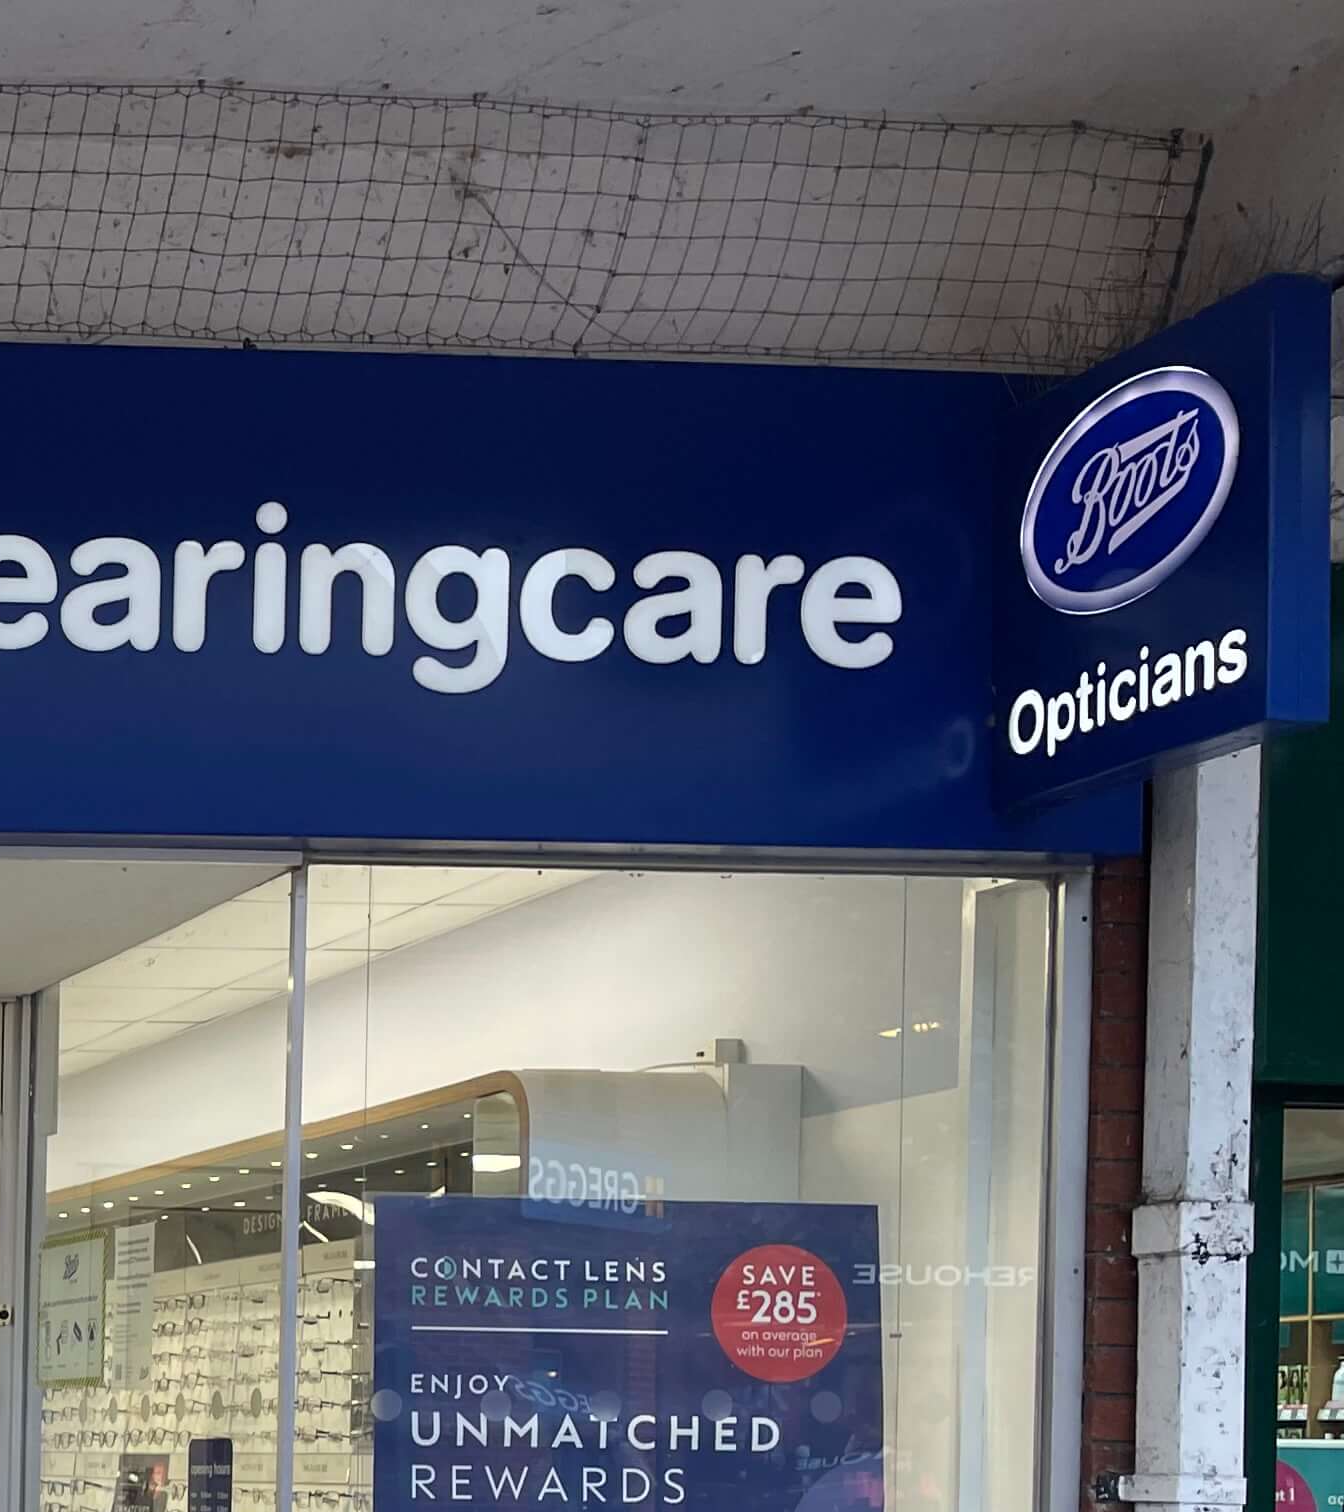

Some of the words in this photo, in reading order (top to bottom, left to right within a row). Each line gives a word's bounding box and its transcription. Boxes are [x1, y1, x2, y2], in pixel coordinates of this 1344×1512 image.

[1055, 408, 1200, 574] Boots
[1009, 628, 1248, 757] Opticians
[411, 1256, 571, 1281] CONTACT
[585, 1260, 666, 1282] LENS
[743, 1265, 815, 1286] SAVE
[412, 1285, 568, 1309] REWARDS
[583, 1288, 668, 1311] PLAN
[742, 1331, 759, 1341] on
[762, 1331, 817, 1346] average
[737, 1345, 765, 1357] with
[768, 1348, 790, 1358] our
[793, 1346, 823, 1361] plan
[411, 1374, 509, 1399] ENJOY
[411, 1411, 780, 1452] UNMATCHED
[411, 1464, 686, 1504] REWARDS
